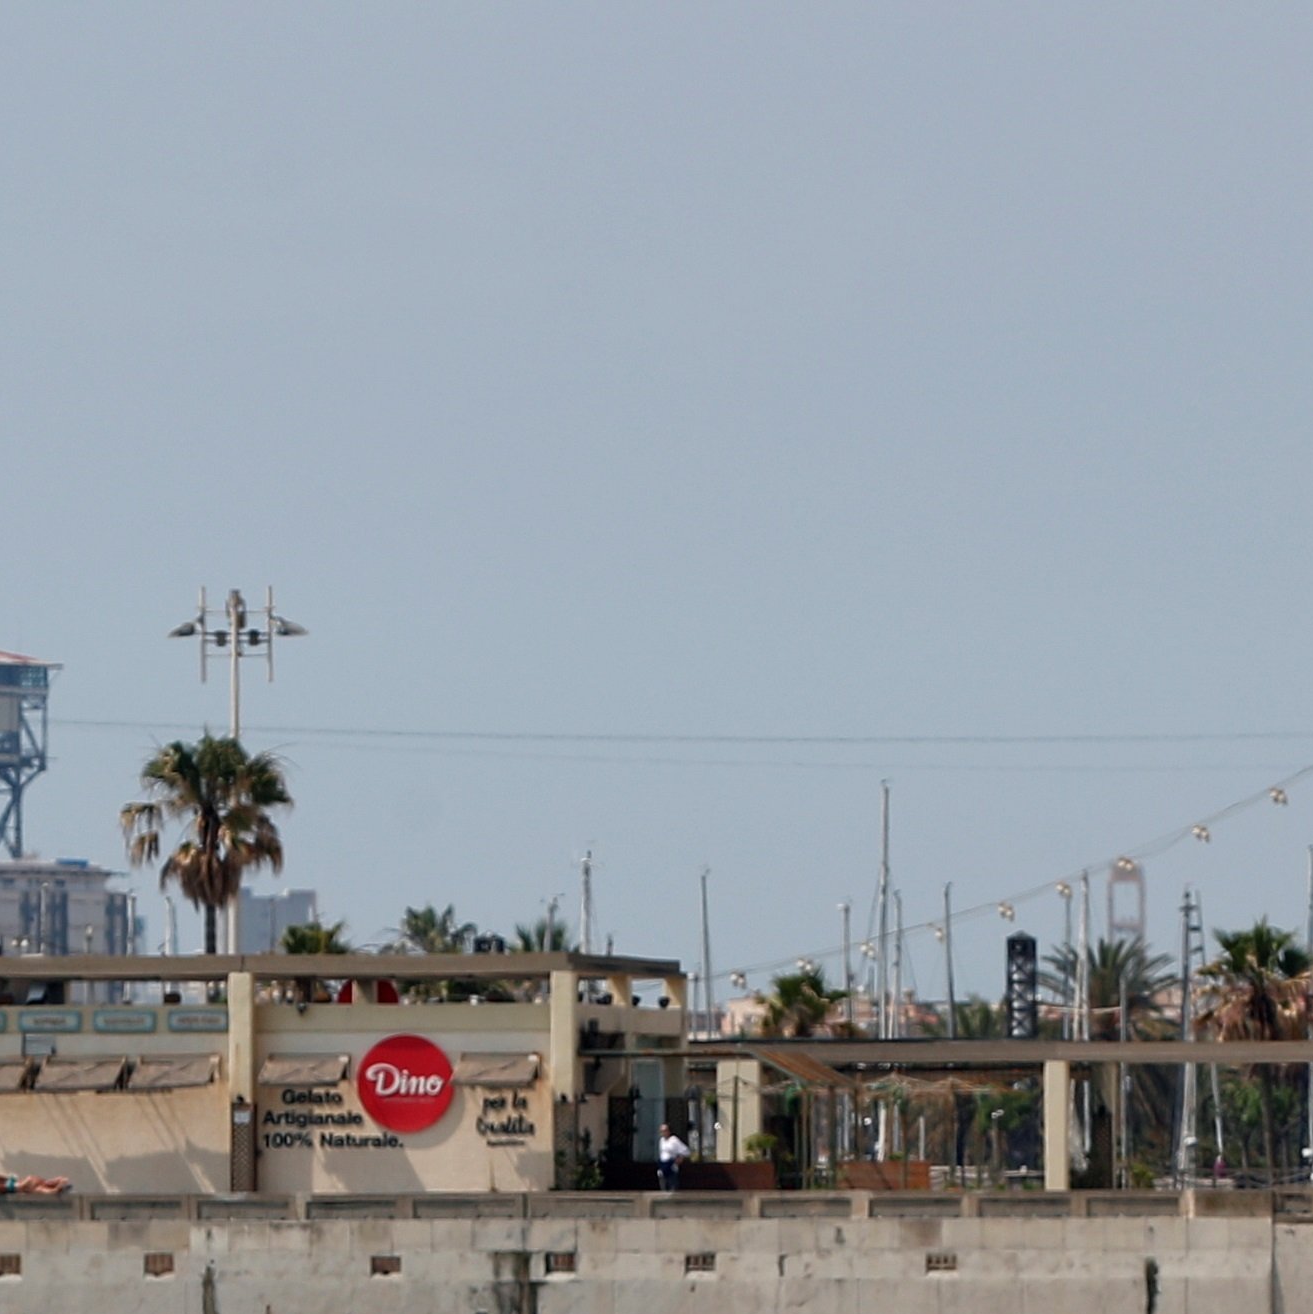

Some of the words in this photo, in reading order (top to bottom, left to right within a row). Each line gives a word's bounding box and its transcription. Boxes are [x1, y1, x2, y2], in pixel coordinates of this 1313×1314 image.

[365, 1062, 443, 1097] Dino
[281, 1088, 343, 1105] Gelato
[262, 1109, 364, 1128] Artigianale
[263, 1132, 314, 1149] 100%
[319, 1131, 405, 1149] Naturale.
